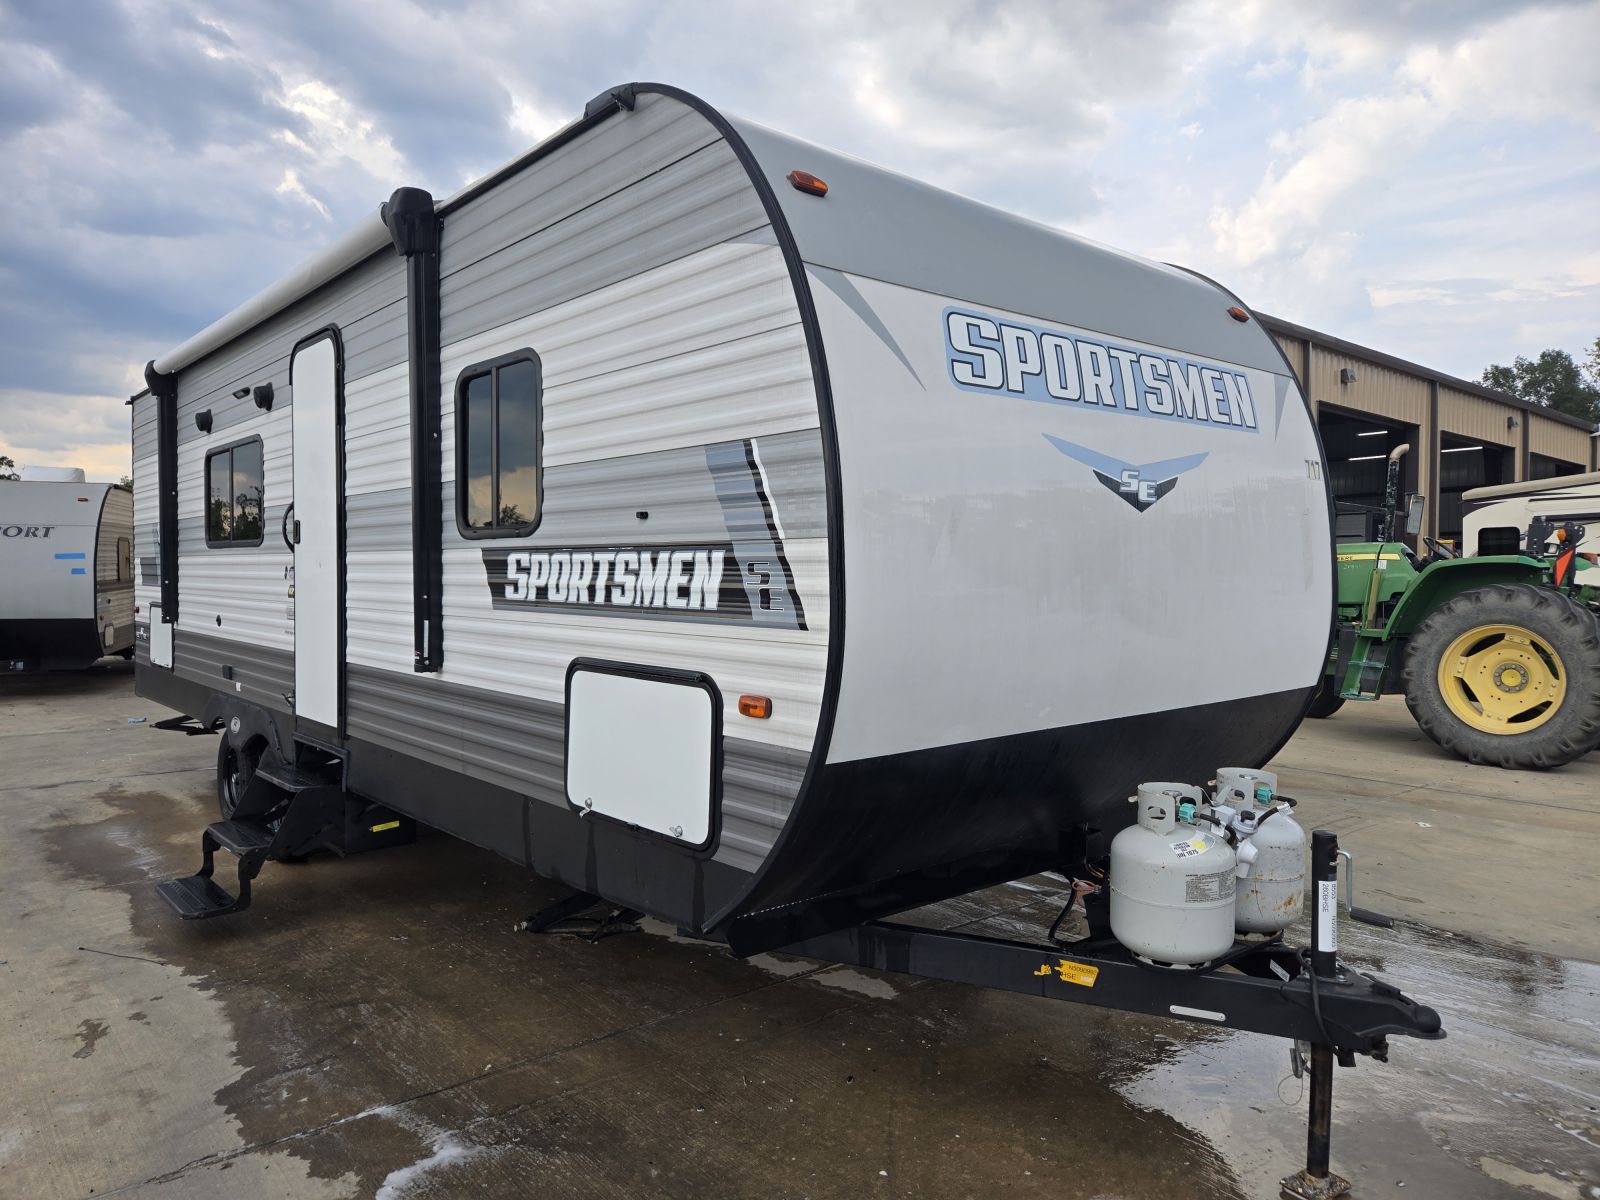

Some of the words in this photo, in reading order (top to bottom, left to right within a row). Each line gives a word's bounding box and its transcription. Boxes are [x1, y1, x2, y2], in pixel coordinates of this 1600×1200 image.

[947, 311, 1257, 429] SPORTSMEN
[1119, 468, 1158, 504] SE
[0, 524, 55, 538] ORT
[504, 549, 725, 611] SPORTSMEN
